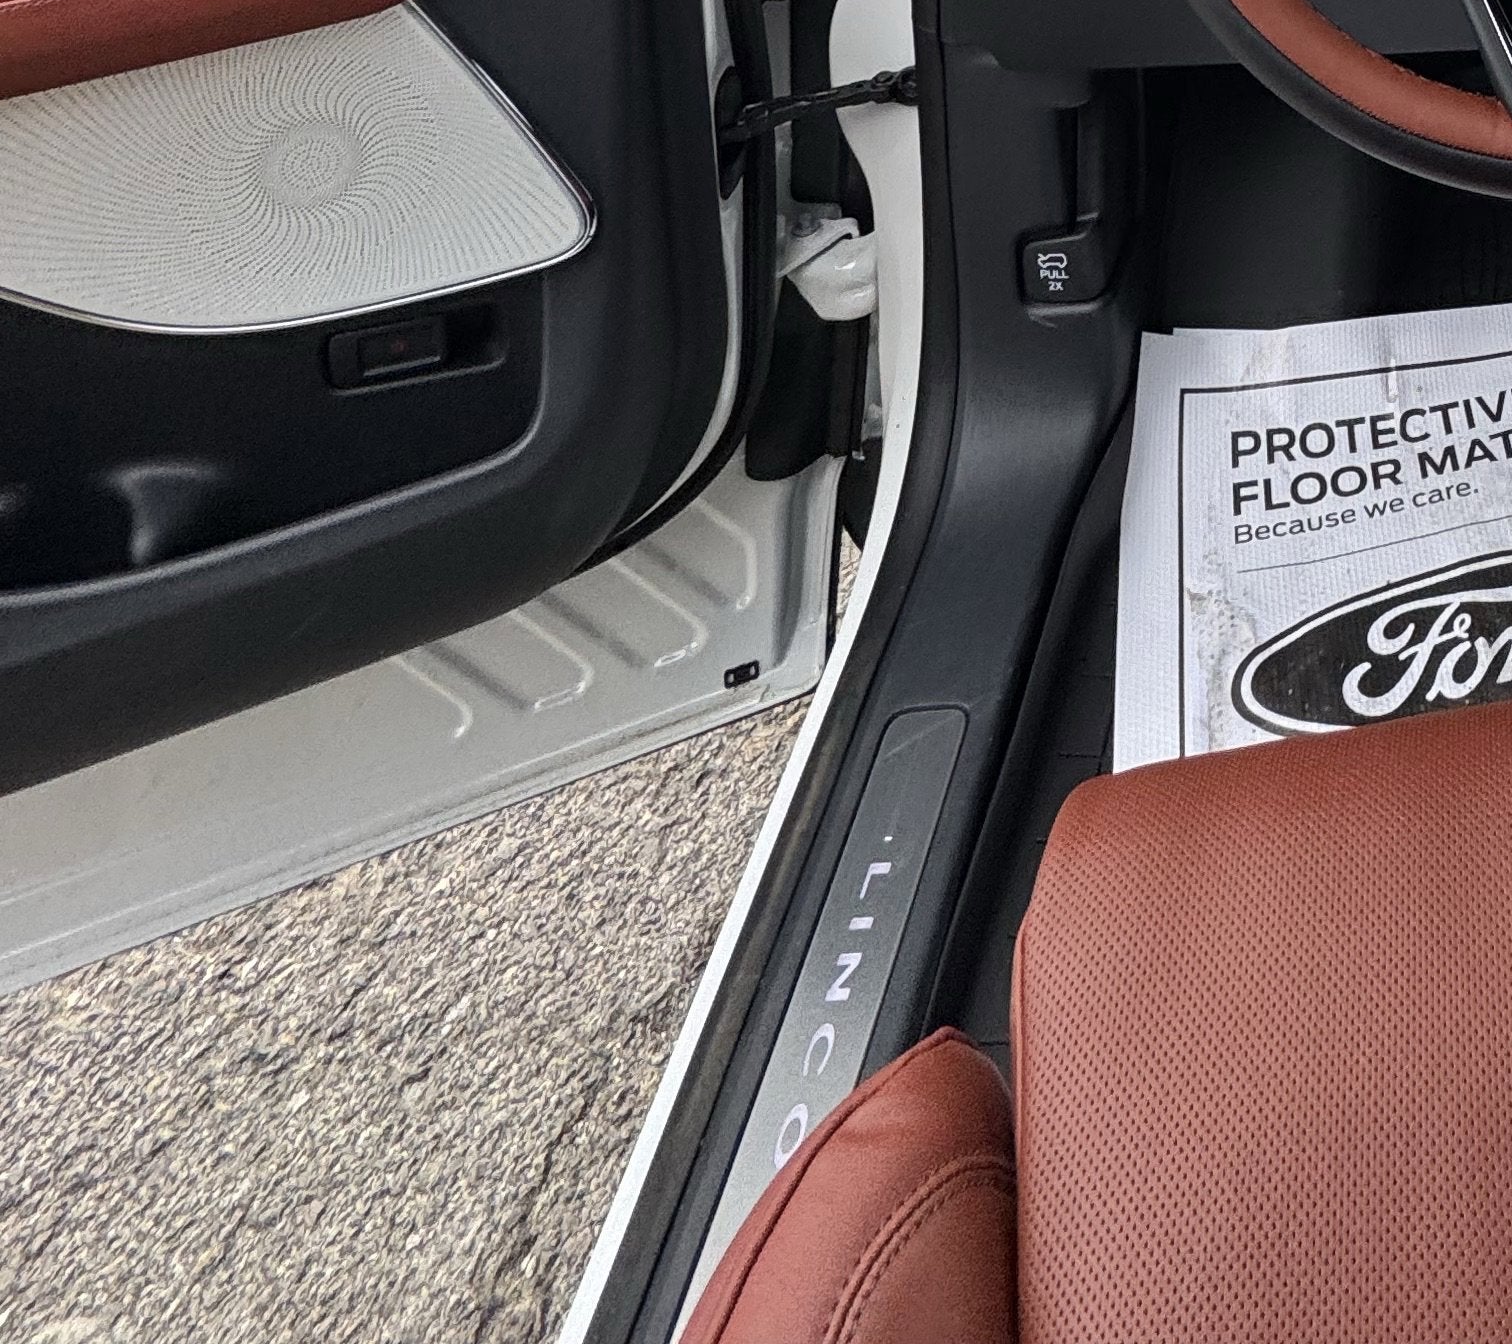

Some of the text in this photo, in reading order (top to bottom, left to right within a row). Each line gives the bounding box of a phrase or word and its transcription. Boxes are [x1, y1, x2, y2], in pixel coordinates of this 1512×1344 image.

[1040, 269, 1070, 279] PULL
[1048, 281, 1063, 291] 2X
[1231, 460, 1403, 516] FLOOR
[1234, 480, 1479, 545] Because we care.
